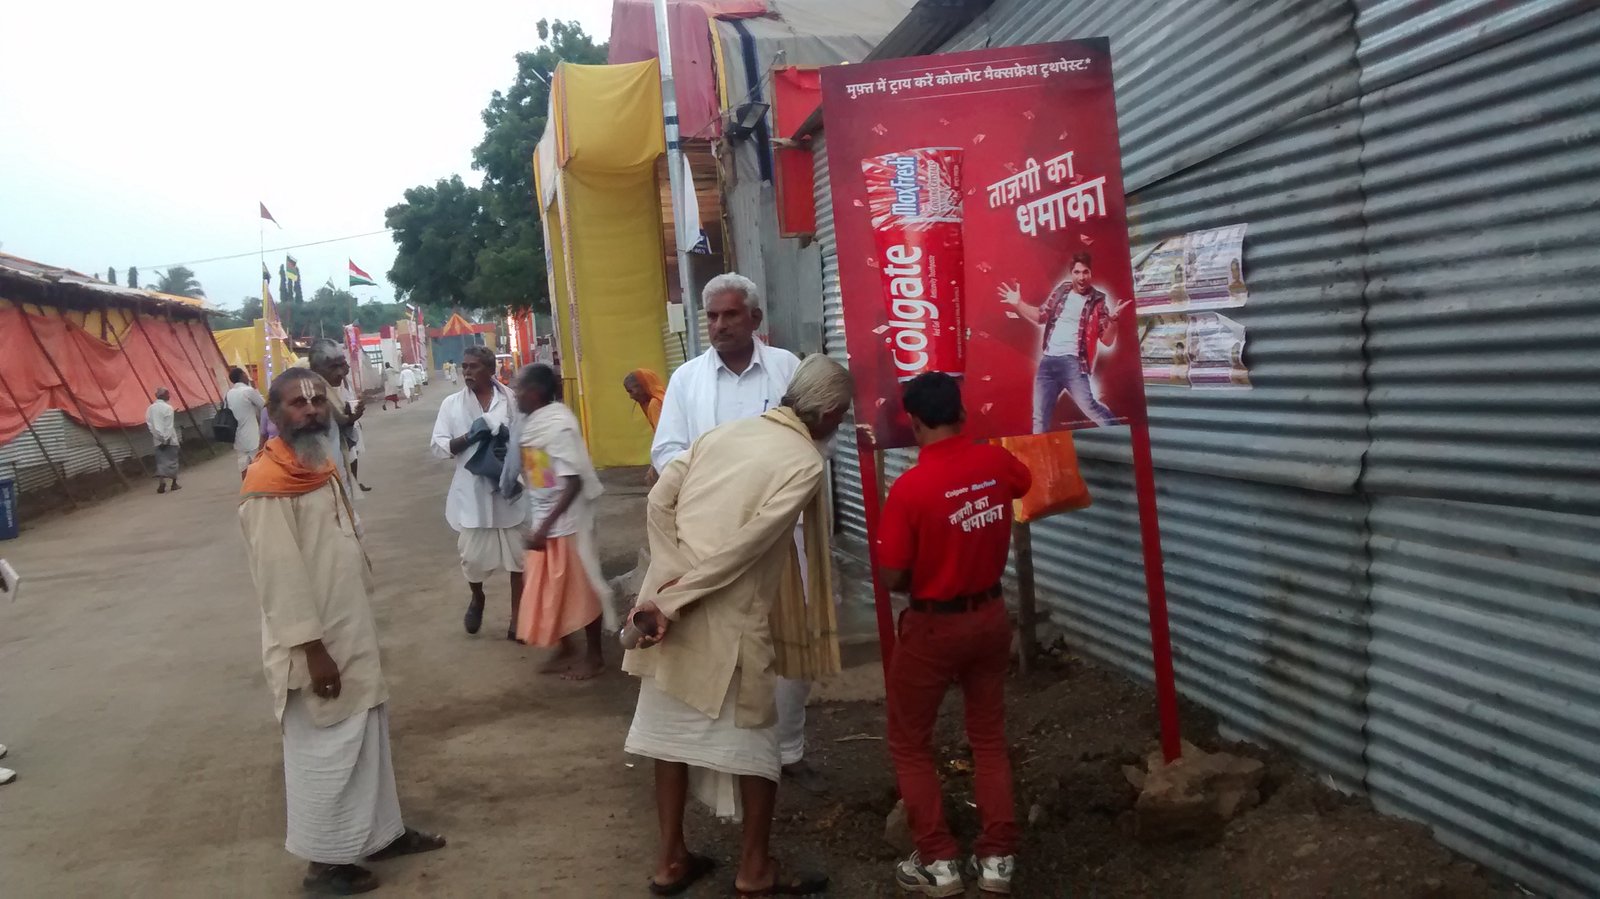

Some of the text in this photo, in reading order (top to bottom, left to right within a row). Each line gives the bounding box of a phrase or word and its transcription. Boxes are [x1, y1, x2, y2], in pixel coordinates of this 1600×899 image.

[876, 78, 887, 92] में
[888, 78, 912, 94] ट्राय
[913, 72, 934, 88] करें
[935, 68, 982, 85] कोलगेट
[984, 63, 1038, 80] मैक्सफ्रेश
[888, 156, 920, 216] MaxFresh
[986, 150, 1074, 208] ताज़गी का
[1016, 176, 1107, 237] धमाका
[883, 244, 939, 370] Colgate
[962, 504, 1004, 532] धमाका
[974, 496, 989, 511] का
